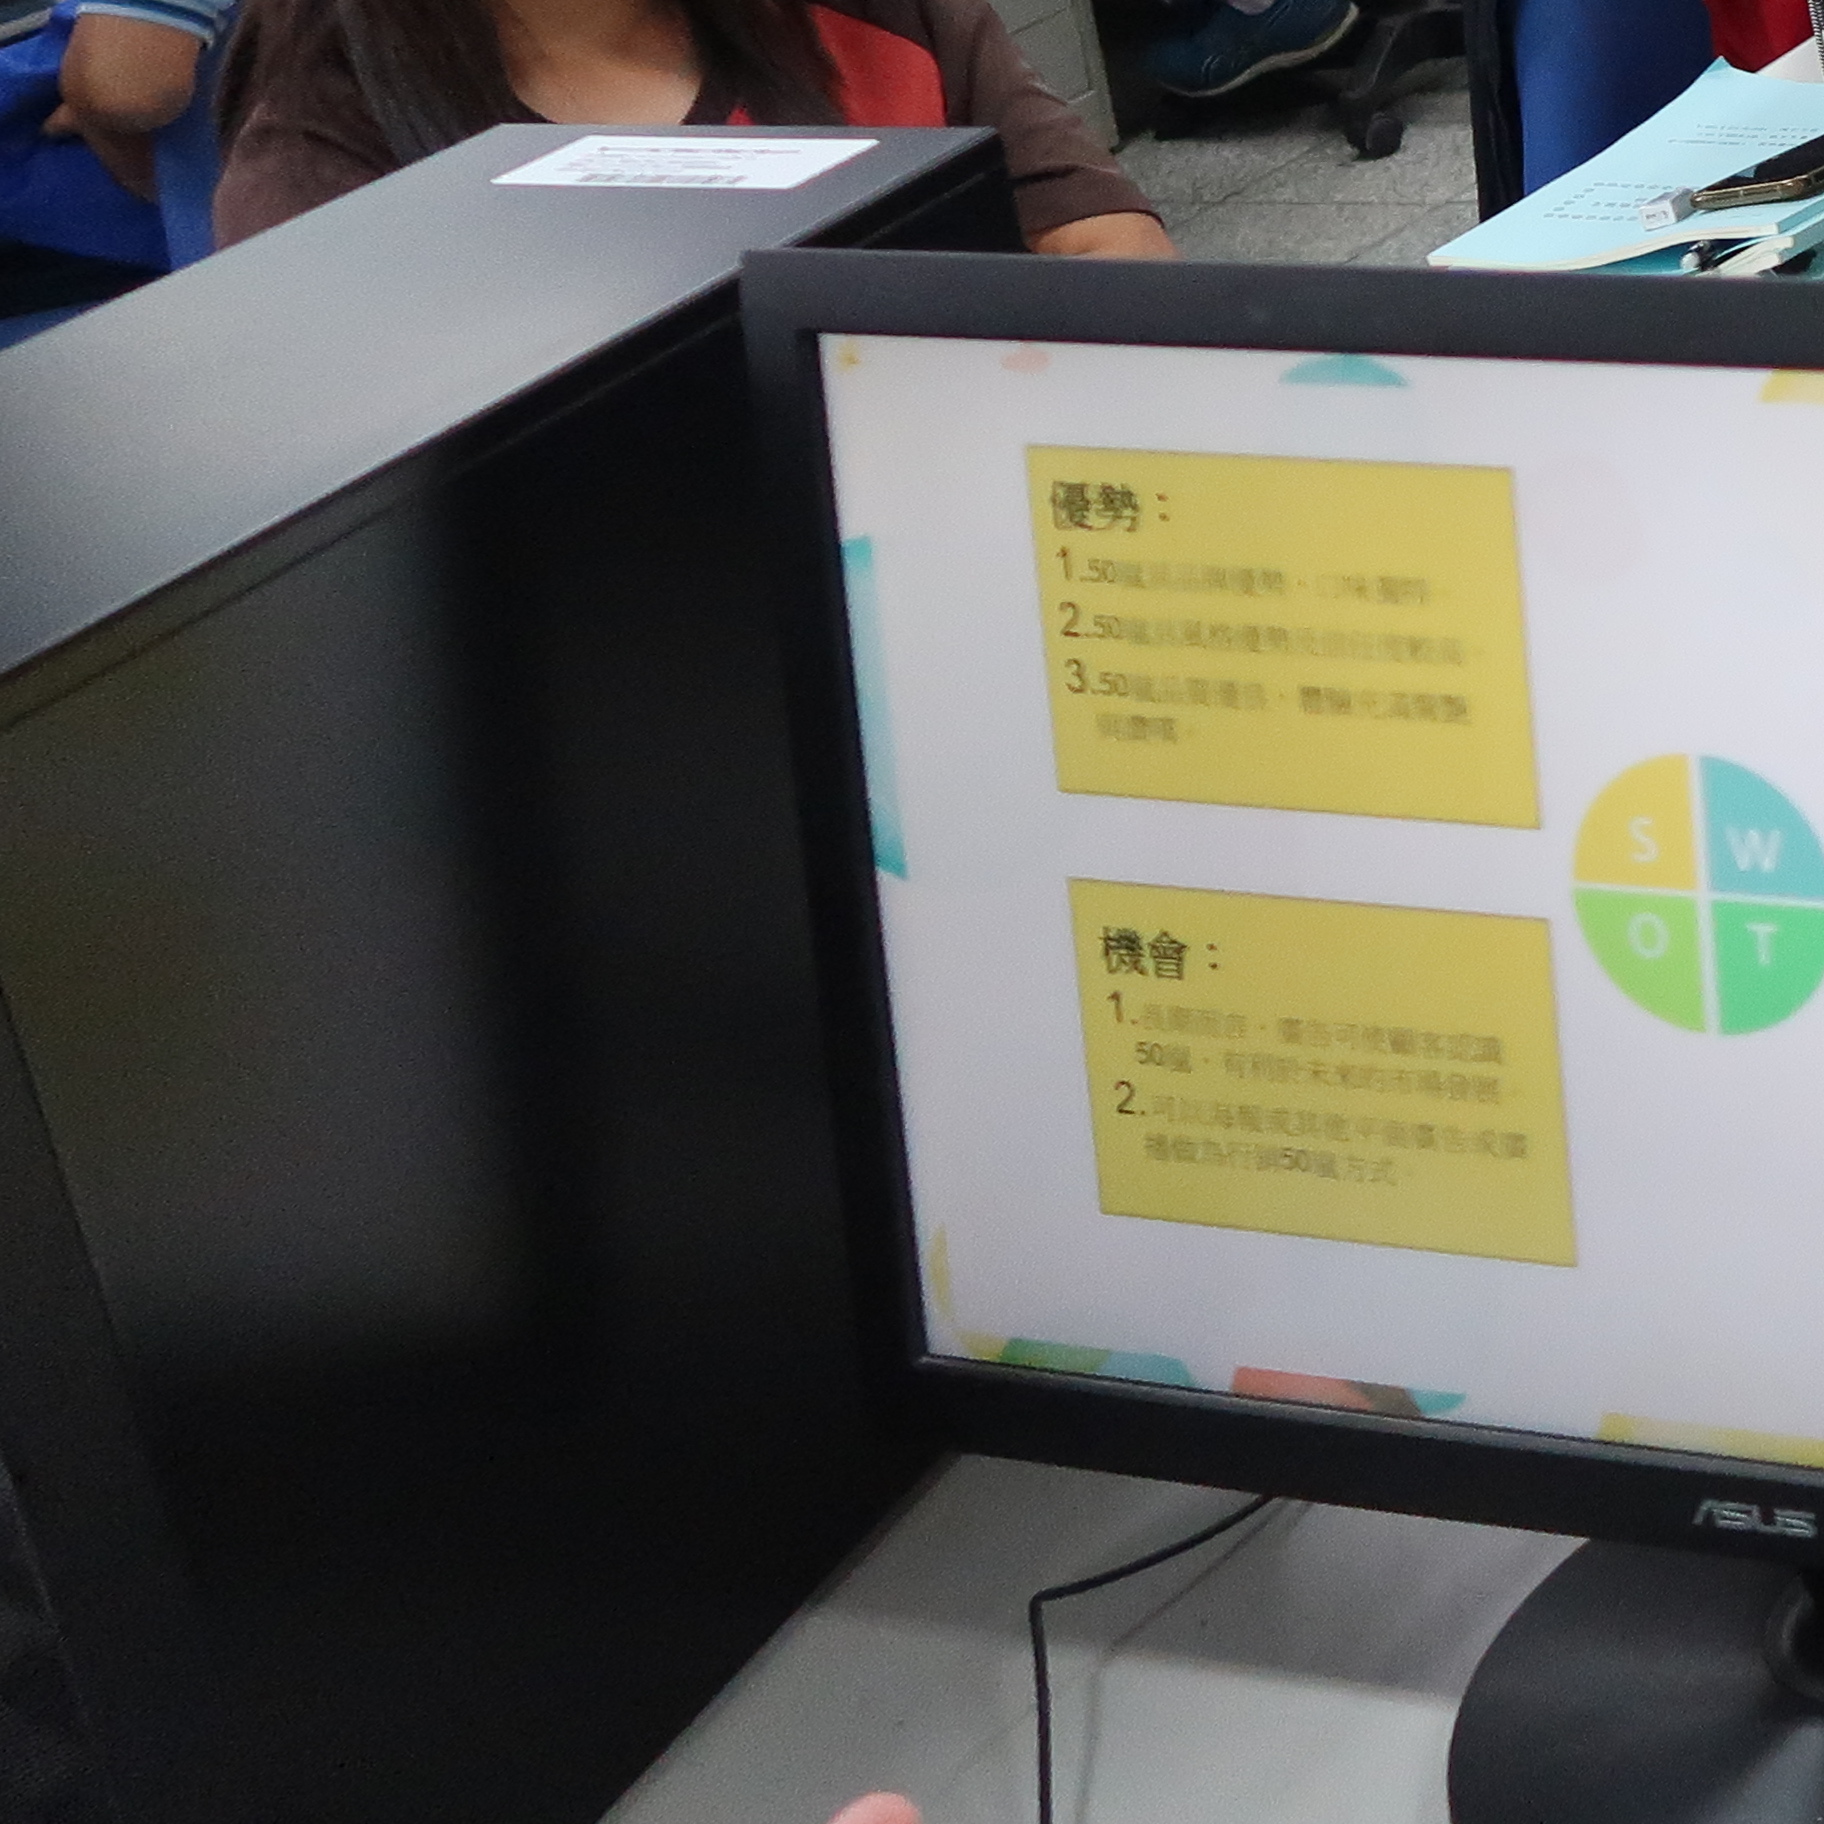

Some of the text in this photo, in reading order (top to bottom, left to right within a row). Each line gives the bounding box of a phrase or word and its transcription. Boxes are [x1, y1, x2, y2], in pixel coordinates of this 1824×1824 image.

[1626, 815, 1783, 874] S W
[1098, 924, 1219, 981] 機會：
[1627, 911, 1780, 967] O T
[1691, 1498, 1818, 1537] ASUS
